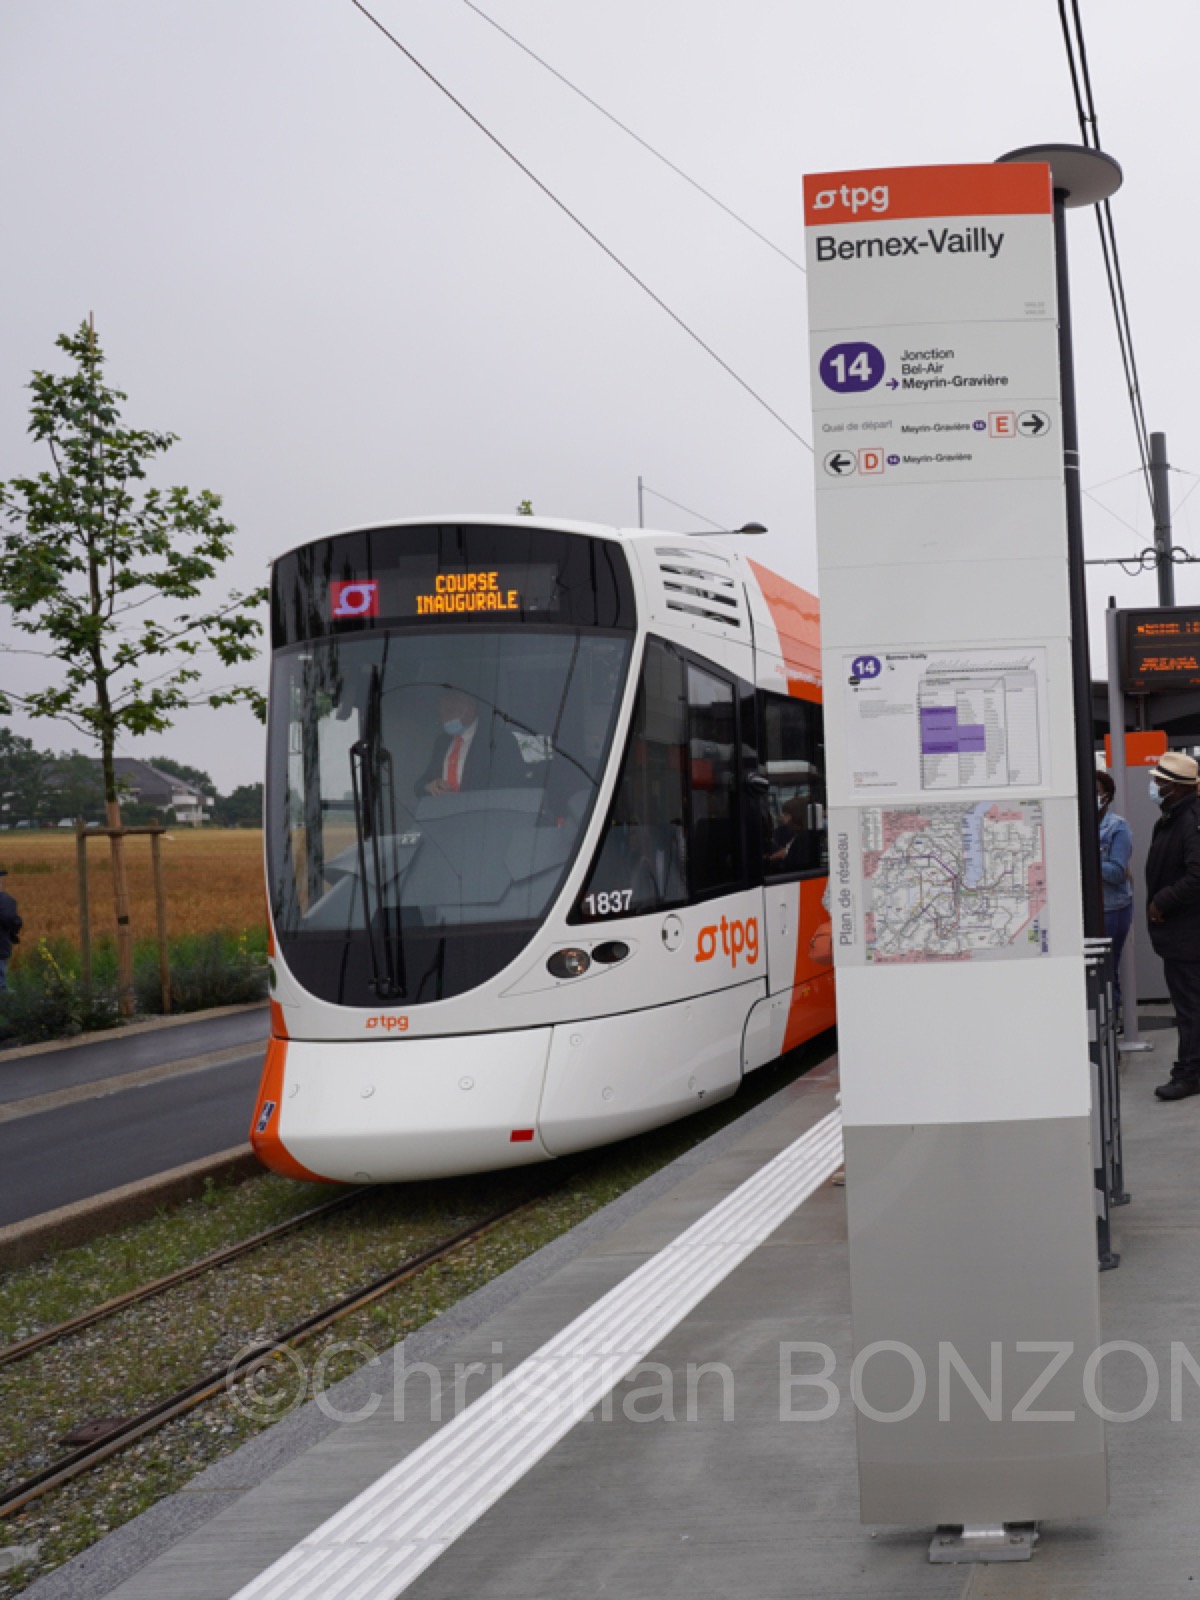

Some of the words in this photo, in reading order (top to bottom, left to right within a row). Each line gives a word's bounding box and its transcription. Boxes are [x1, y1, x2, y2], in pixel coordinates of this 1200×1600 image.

[814, 226, 1005, 262] Bernex-Vailly
[900, 348, 955, 362] Jonction
[829, 351, 873, 384] 14
[901, 361, 944, 376] Bel-Air
[901, 373, 1009, 391] Meyrin-Gravière
[821, 423, 844, 433] Quai
[846, 422, 859, 432] de
[861, 419, 893, 433] départ
[996, 416, 1009, 433] E
[864, 453, 879, 470] D
[435, 571, 499, 594] COURSE
[416, 589, 518, 615] INAUGURALE
[856, 660, 876, 675] 14
[836, 832, 850, 885] réseau
[585, 889, 633, 916] 1837
[837, 887, 851, 909] de
[840, 913, 853, 946] Plan
